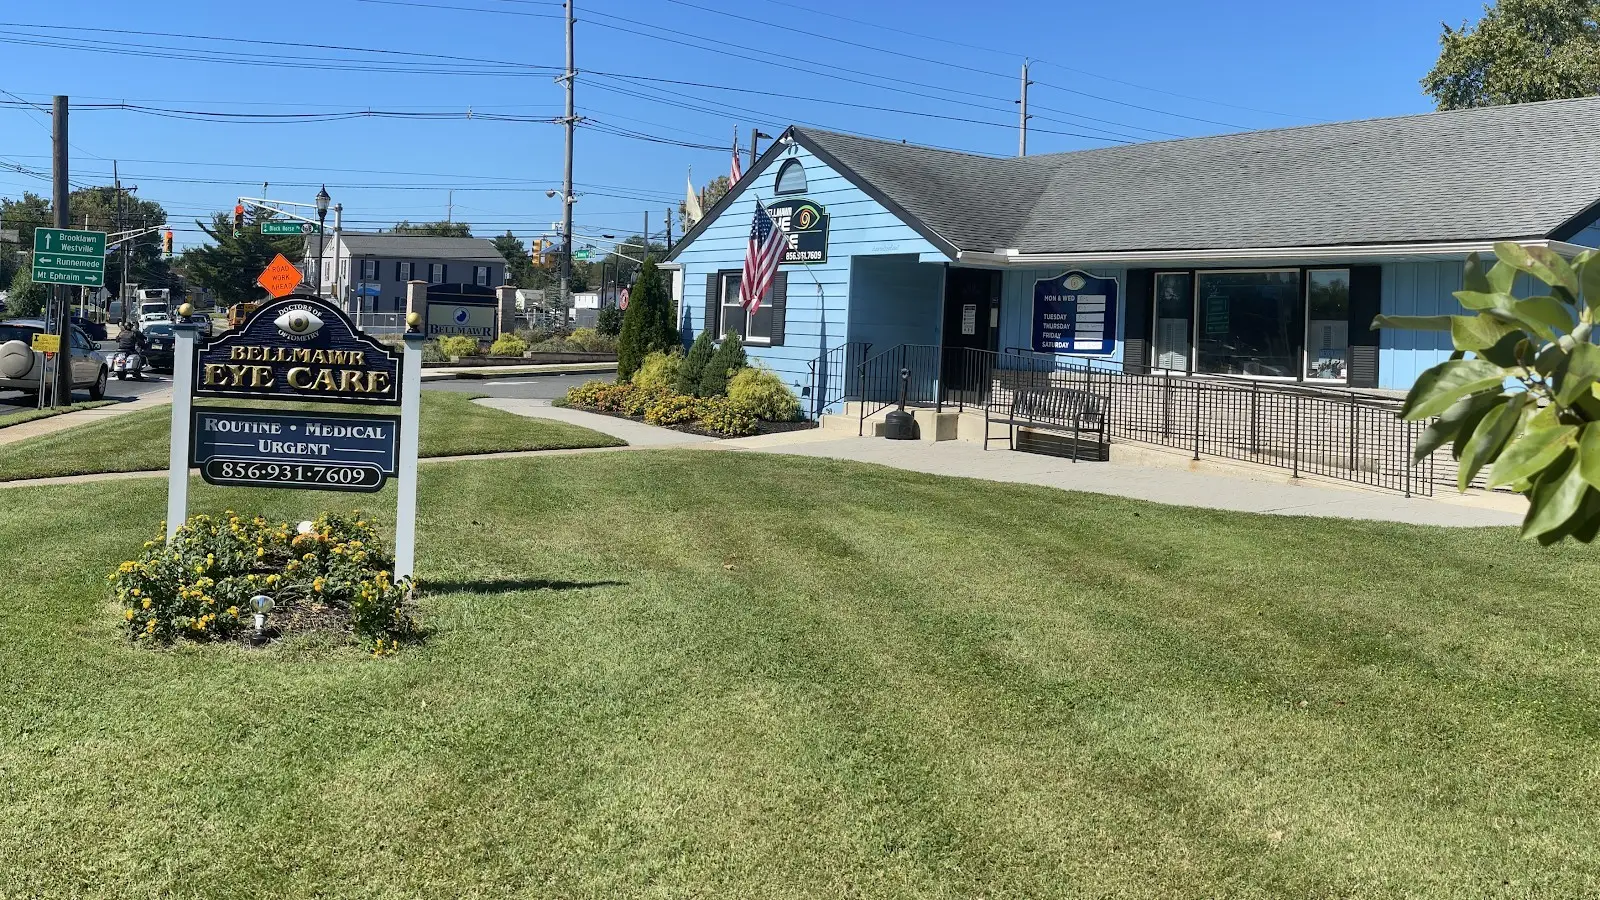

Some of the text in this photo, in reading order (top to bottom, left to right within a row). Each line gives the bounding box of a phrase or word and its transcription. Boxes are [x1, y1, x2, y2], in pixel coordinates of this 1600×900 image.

[59, 233, 97, 243] Brooklawn
[61, 243, 94, 253] Westville
[56, 257, 100, 268] Runnemede
[271, 265, 290, 273] ROAD
[37, 270, 80, 281] Mt Ephraim
[271, 282, 293, 291] AHEAD
[278, 303, 323, 318] DOCTORS OF
[1043, 313, 1067, 321] TUESDAY
[430, 323, 492, 337] BELLMAWR
[1042, 322, 1071, 330] THURSDAY
[277, 329, 320, 342] OPTOMETRY
[1042, 331, 1061, 339] FRIDAY
[1041, 341, 1070, 349] SATURDAY
[230, 345, 366, 366] BELLMAWR
[203, 363, 391, 394] EYE CARE
[204, 417, 387, 440] ROUTINE MEDICAL
[258, 439, 331, 456] URGENT
